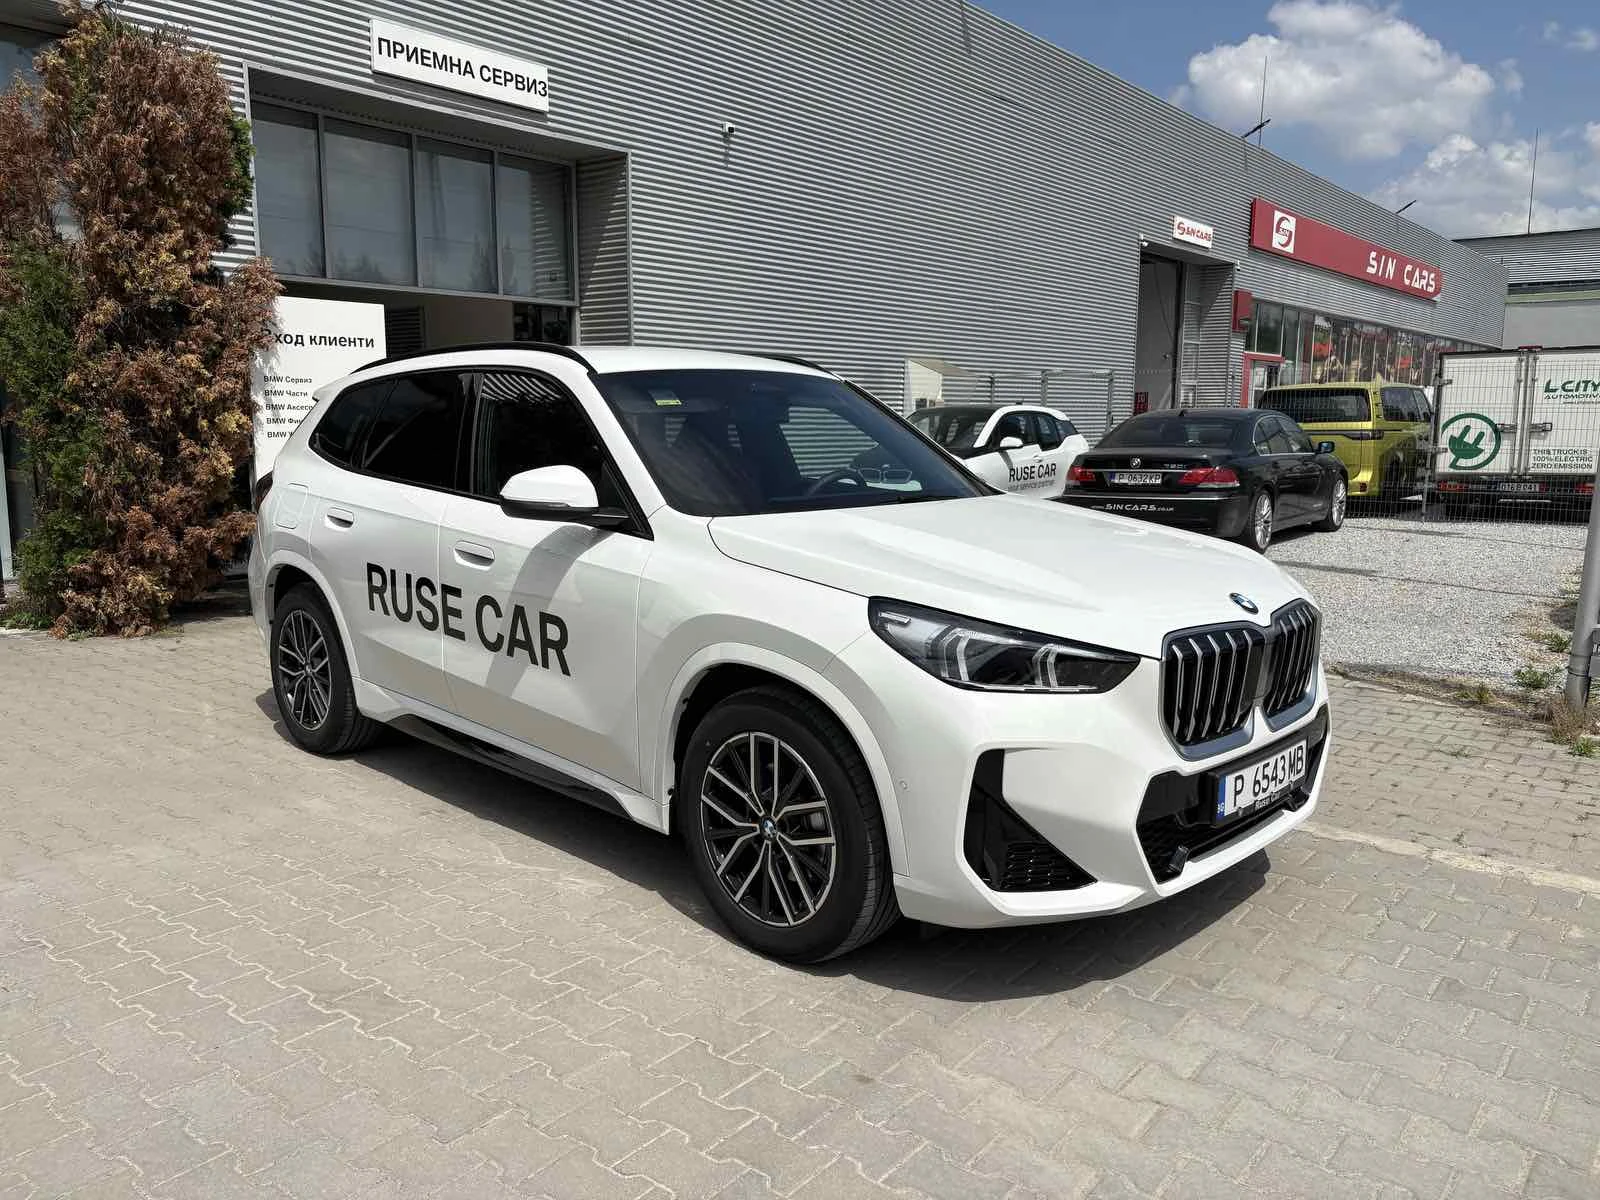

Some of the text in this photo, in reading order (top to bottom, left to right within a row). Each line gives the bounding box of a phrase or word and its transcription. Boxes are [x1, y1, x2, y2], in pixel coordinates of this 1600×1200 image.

[377, 37, 548, 97] ПРИЕМНА СЕРВИЗ
[1366, 251, 1436, 292] SIN CARS
[310, 334, 374, 348] клиенти
[264, 375, 312, 384] BMW Сервиз
[265, 389, 284, 397] BMW
[266, 403, 285, 411] BMW
[267, 417, 286, 425] BMW
[1552, 448, 1580, 456] TRUCK
[1008, 463, 1056, 482] RUSE CAR
[366, 562, 571, 677] RUSE CAR
